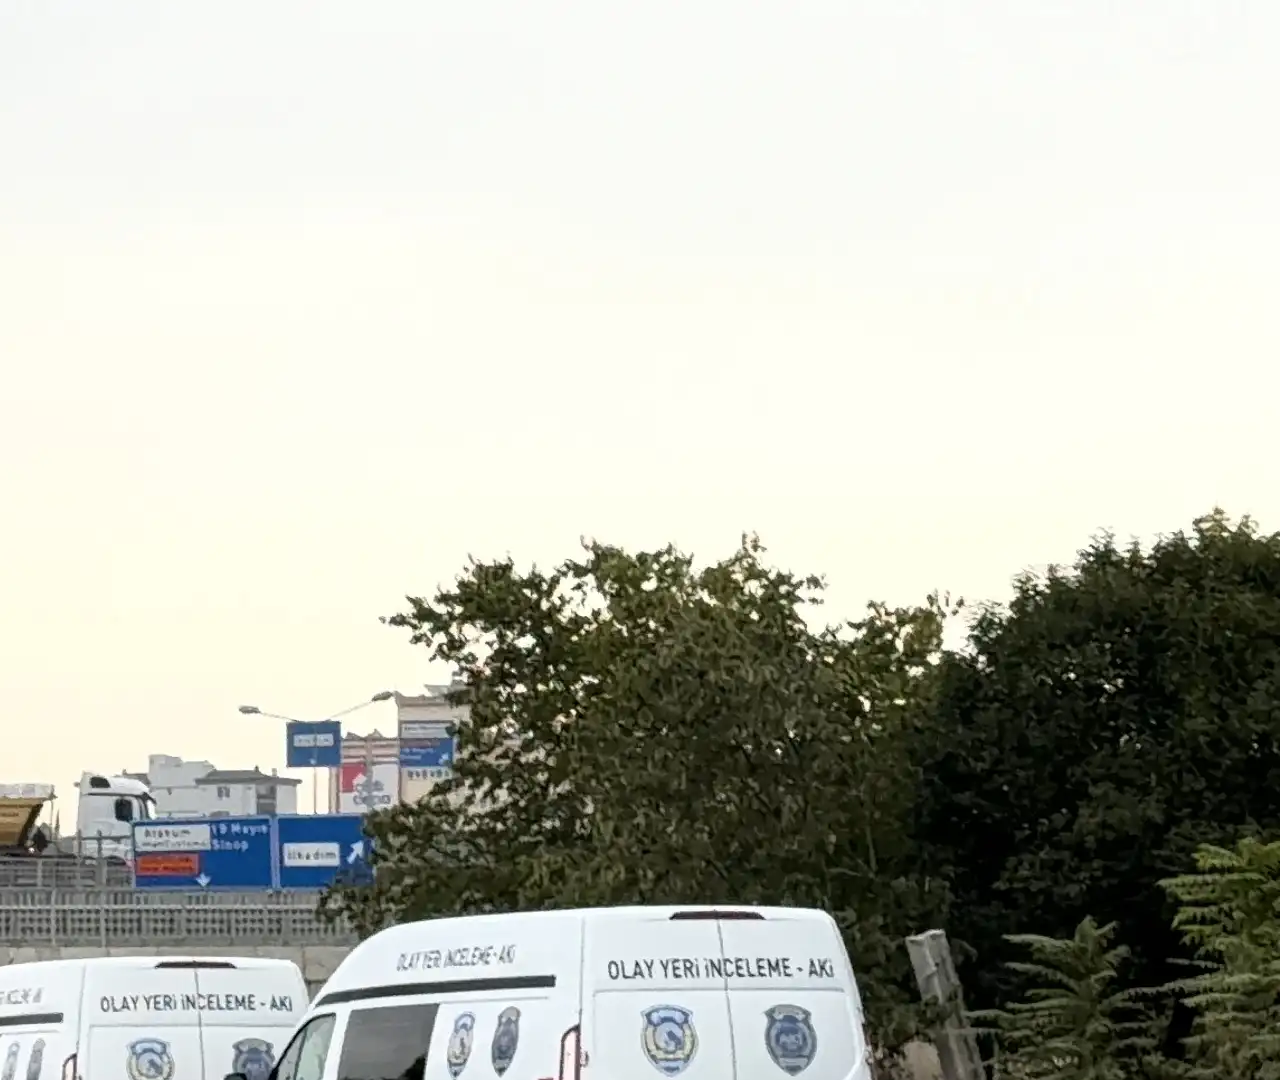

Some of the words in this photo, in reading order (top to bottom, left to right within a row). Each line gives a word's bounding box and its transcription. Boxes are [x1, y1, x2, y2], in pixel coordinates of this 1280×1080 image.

[608, 960, 654, 980] OLAY
[659, 958, 699, 980] YERİ
[705, 957, 790, 979] İNCELEME
[100, 995, 139, 1013] OLAY
